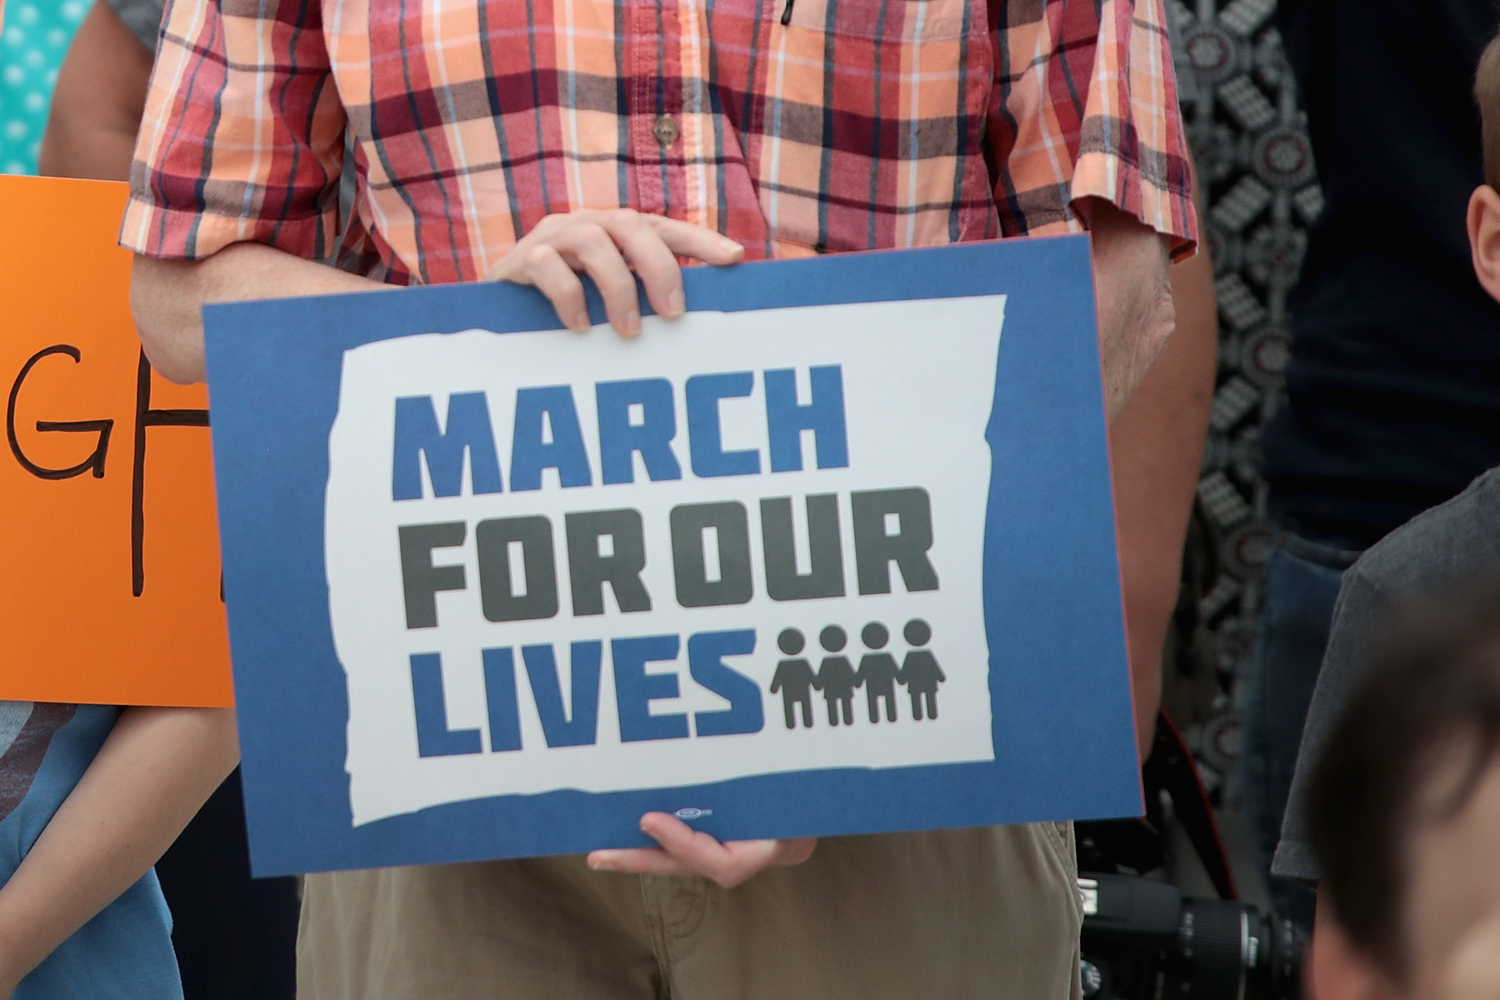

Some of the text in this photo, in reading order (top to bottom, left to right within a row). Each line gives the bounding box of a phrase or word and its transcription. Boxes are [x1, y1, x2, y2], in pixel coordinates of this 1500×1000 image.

[392, 364, 850, 501] MARCH
[397, 486, 940, 630] FOR OUR
[409, 627, 766, 758] LIVES
